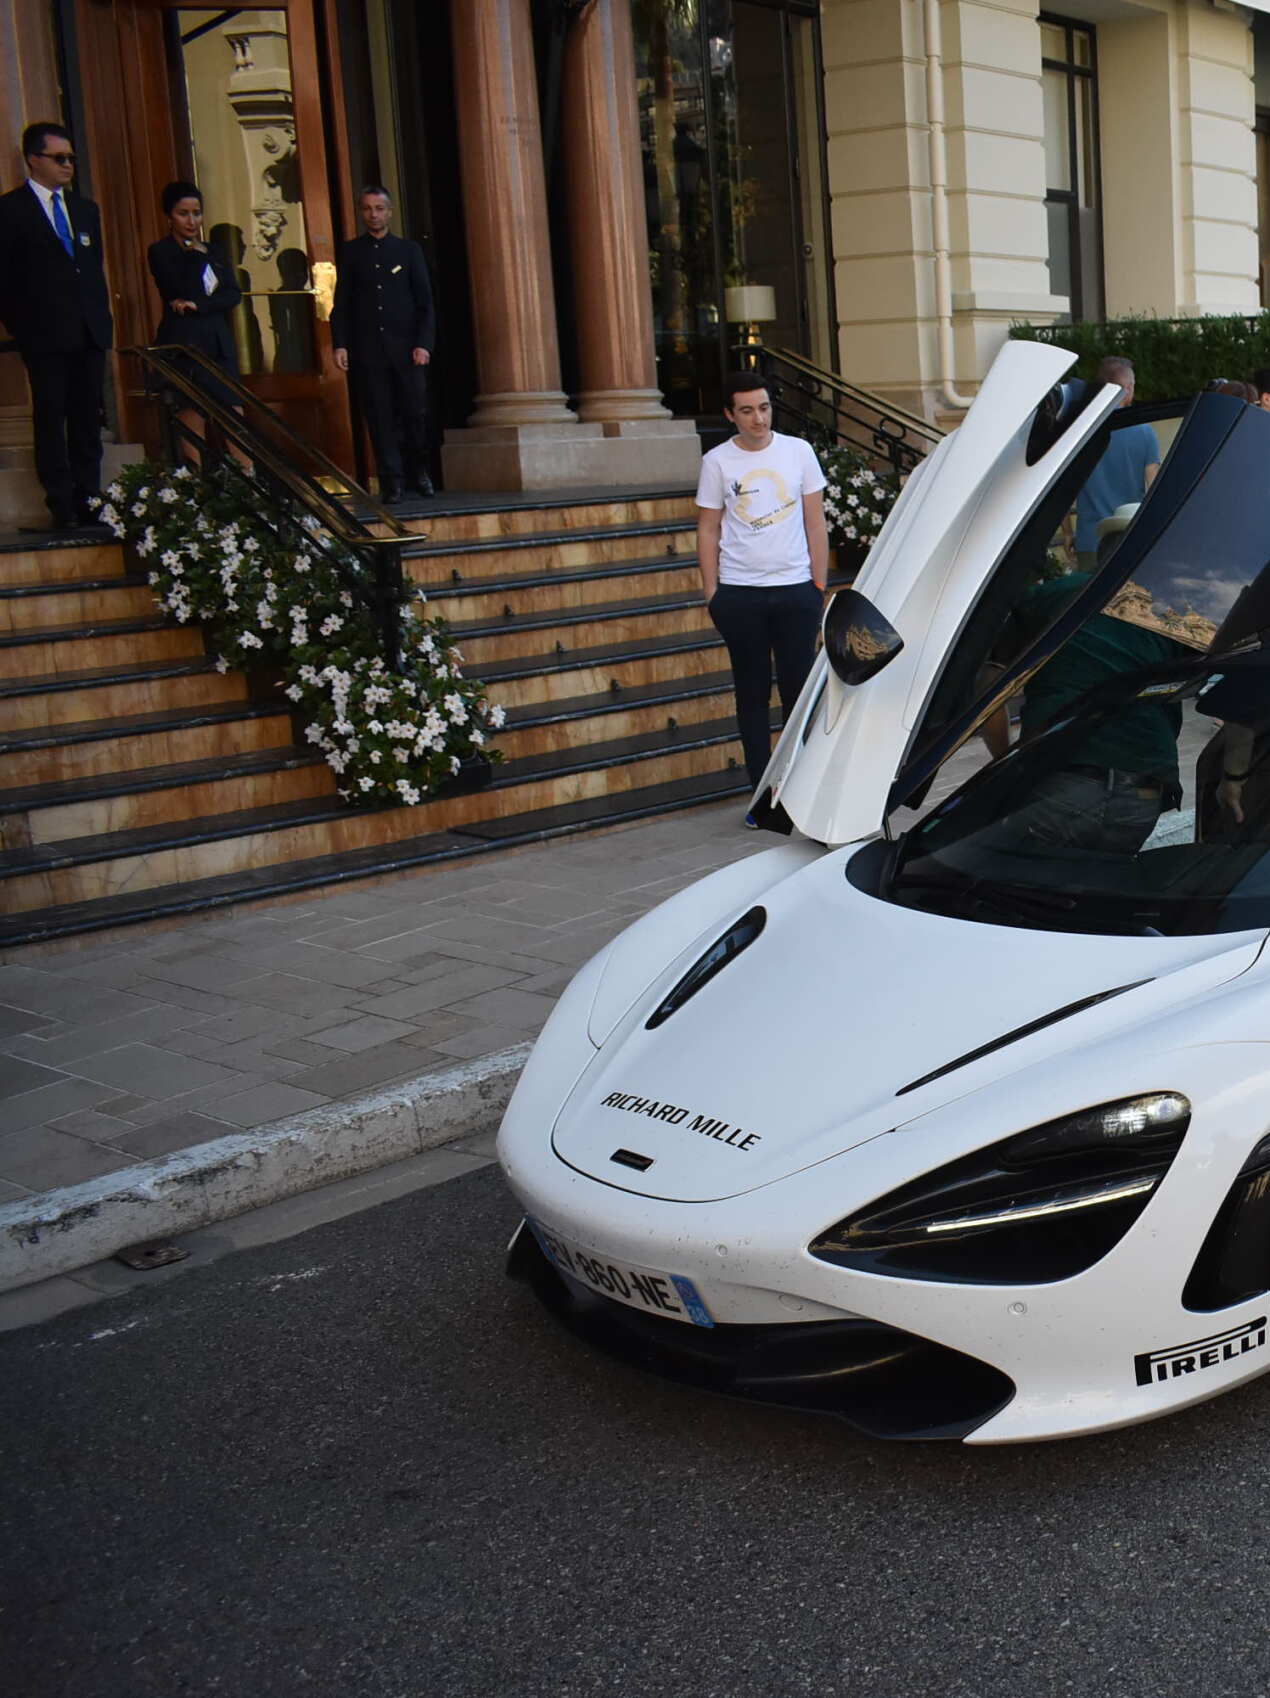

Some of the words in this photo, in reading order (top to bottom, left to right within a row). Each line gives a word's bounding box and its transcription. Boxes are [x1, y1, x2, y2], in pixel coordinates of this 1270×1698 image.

[601, 1091, 690, 1126] RICHARD
[686, 1114, 762, 1152] MILLE
[1134, 1315, 1268, 1387] PIRELLI
